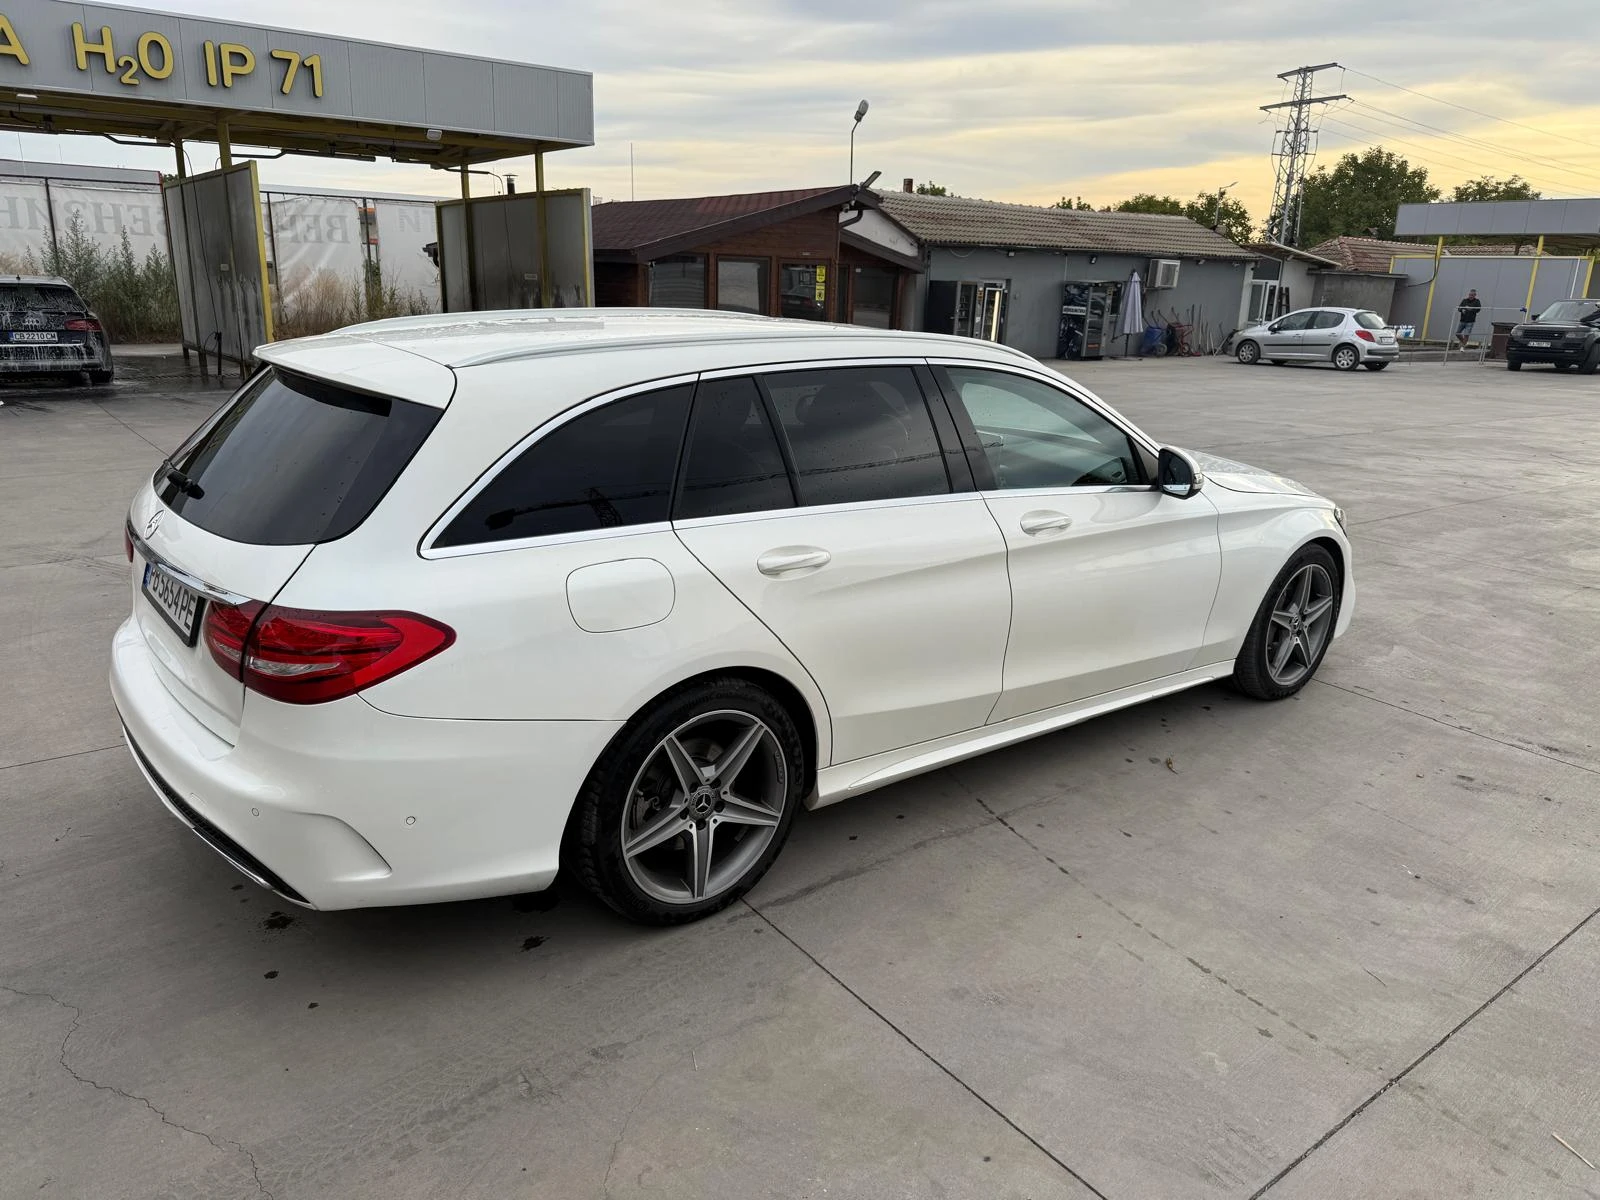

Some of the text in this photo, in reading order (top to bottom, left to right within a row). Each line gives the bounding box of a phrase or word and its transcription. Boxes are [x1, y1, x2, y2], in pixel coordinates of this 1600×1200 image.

[203, 39, 257, 89] IP
[271, 49, 324, 98] 71
[25, 332, 45, 340] 2210
[178, 588, 197, 631] PE
